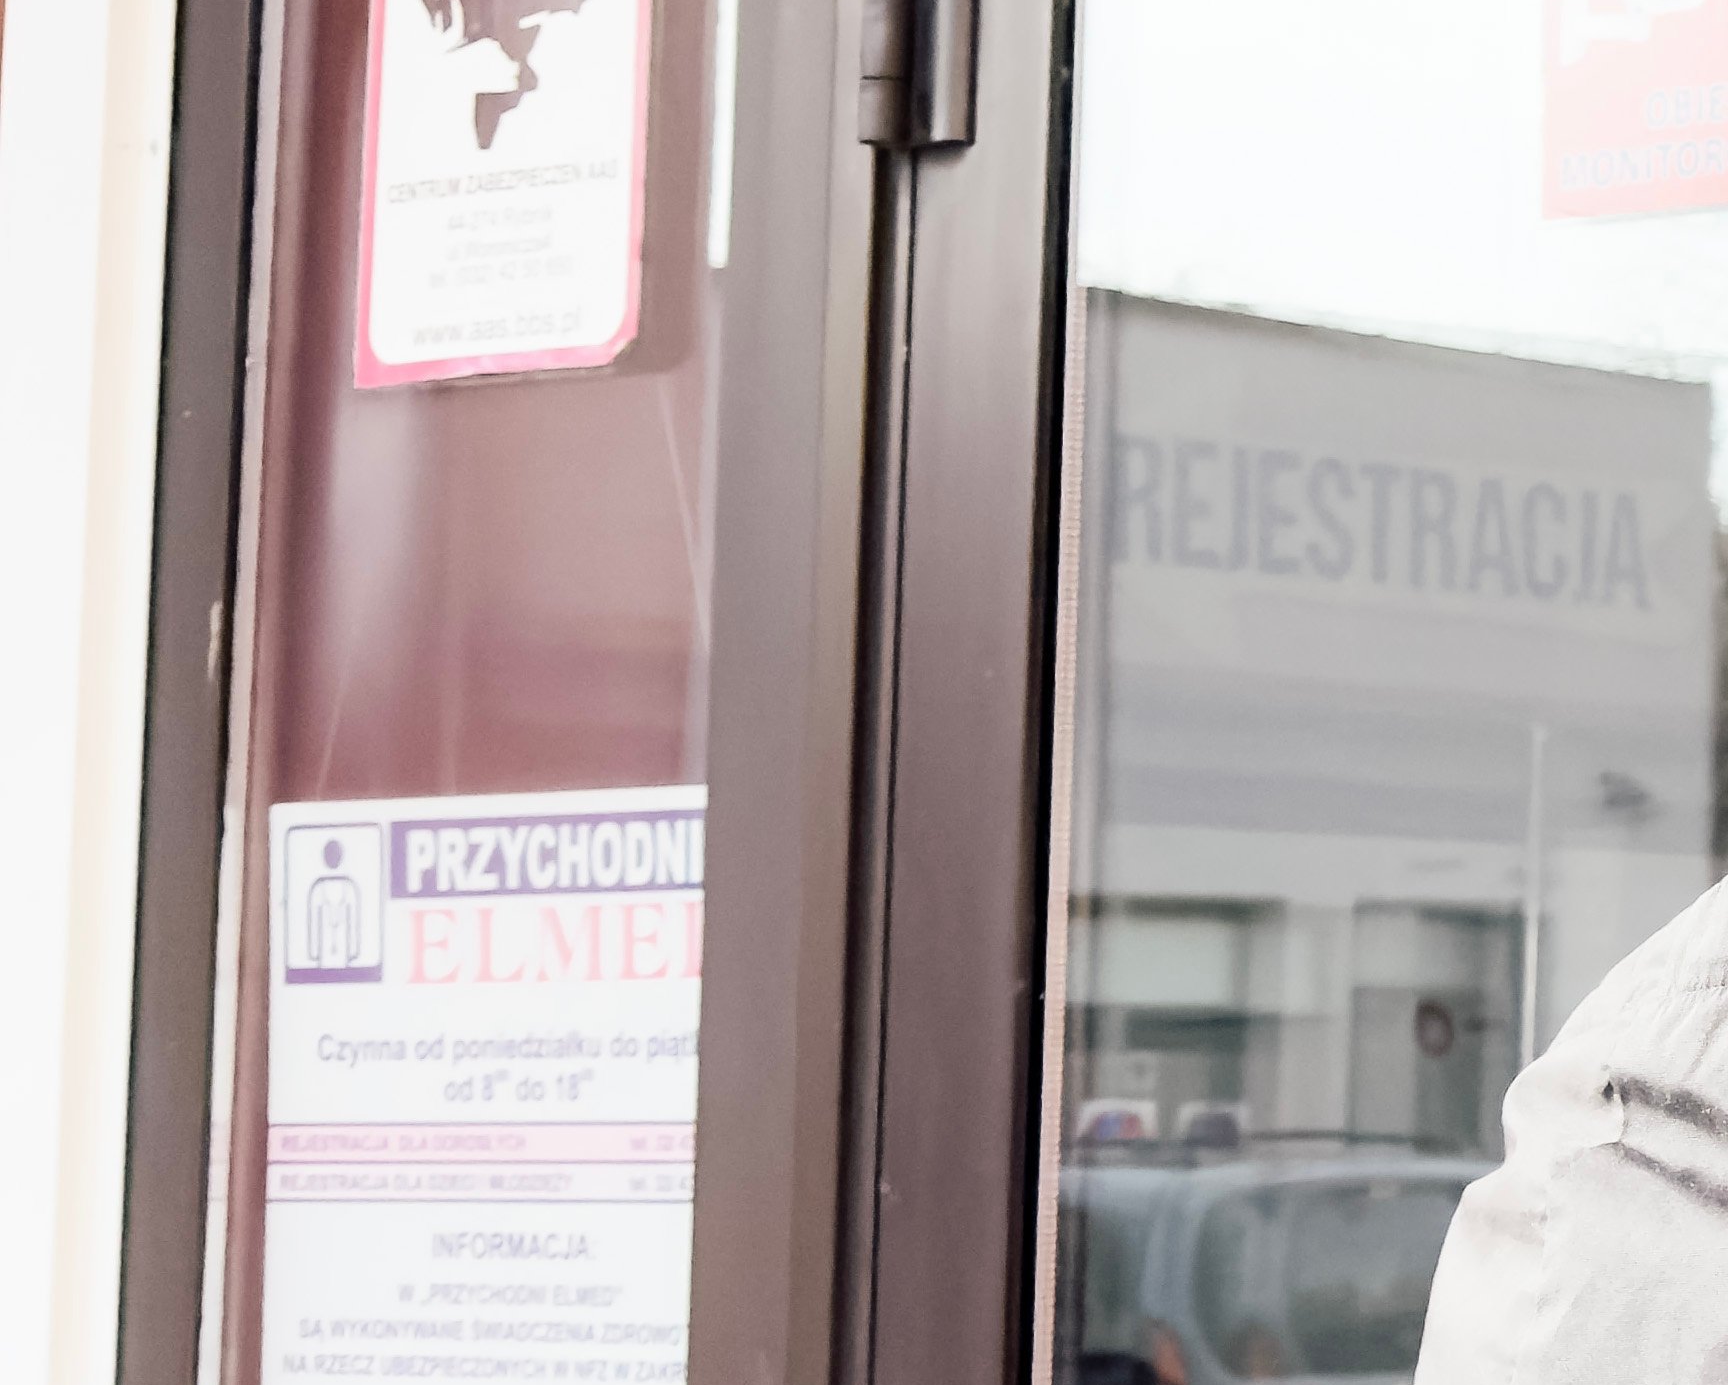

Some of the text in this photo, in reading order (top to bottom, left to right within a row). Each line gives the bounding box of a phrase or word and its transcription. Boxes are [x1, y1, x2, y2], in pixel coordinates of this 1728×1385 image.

[1111, 432, 1650, 609] REJESTRACJA
[414, 1035, 444, 1060] od
[609, 1033, 638, 1059] do
[444, 1076, 473, 1103] od
[515, 1075, 546, 1103] do
